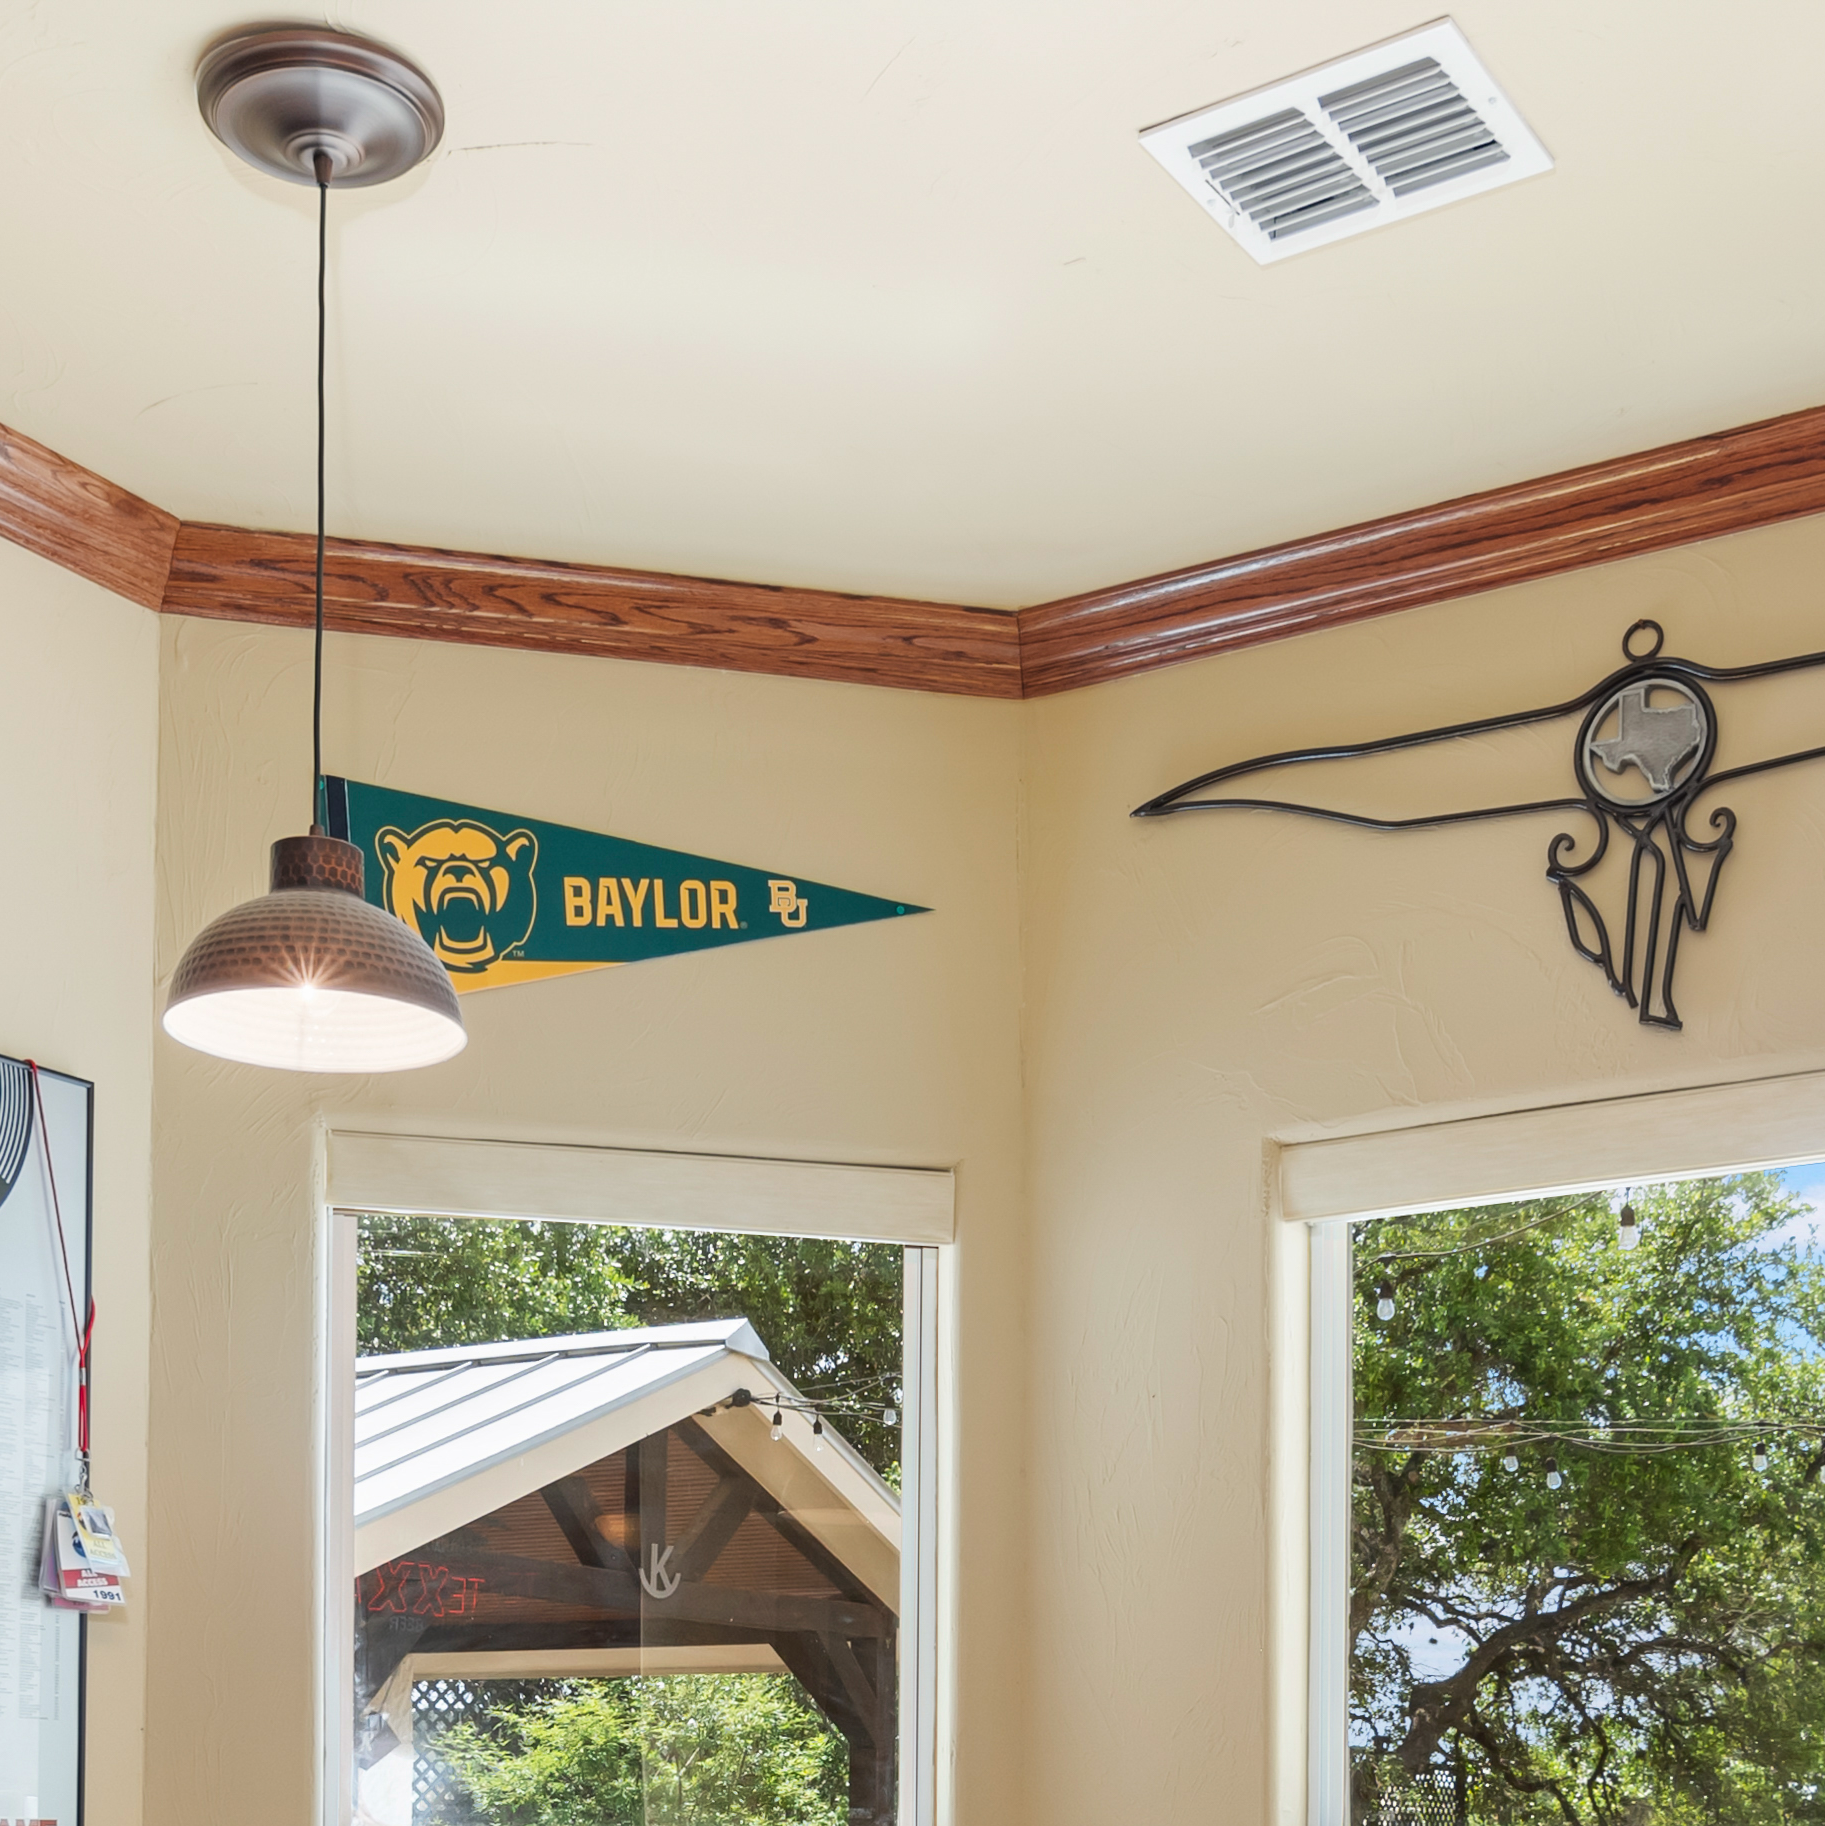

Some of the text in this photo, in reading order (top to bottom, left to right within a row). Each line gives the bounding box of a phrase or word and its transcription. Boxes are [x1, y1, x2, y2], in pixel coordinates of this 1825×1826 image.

[563, 876, 808, 930] BAYLOR BU
[92, 1588, 122, 1602] 1991
